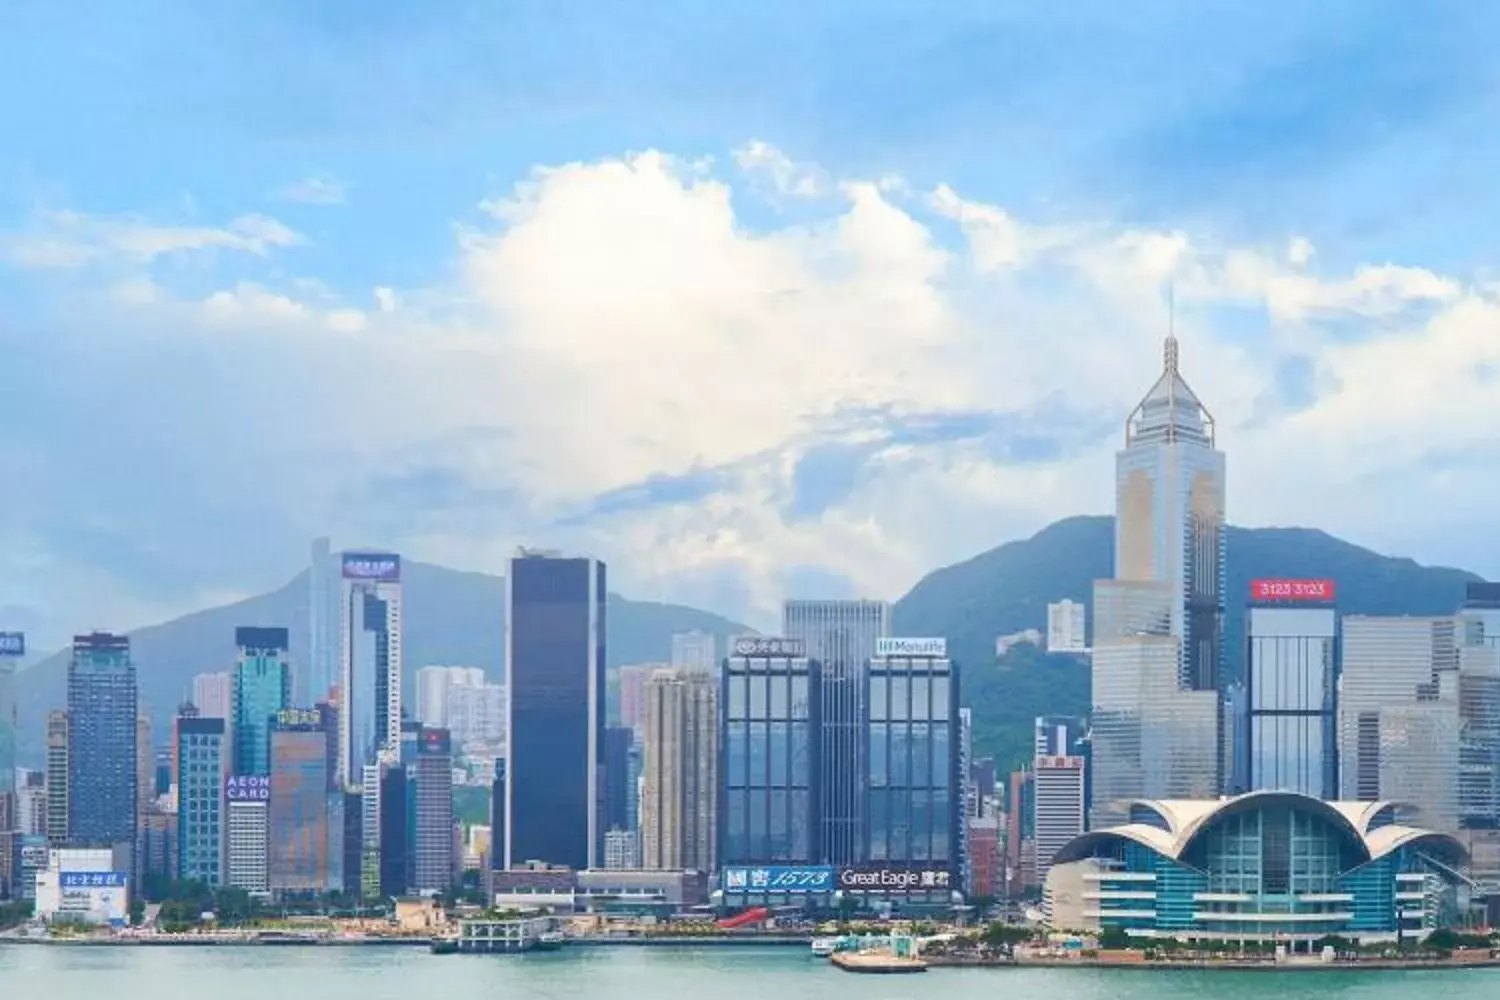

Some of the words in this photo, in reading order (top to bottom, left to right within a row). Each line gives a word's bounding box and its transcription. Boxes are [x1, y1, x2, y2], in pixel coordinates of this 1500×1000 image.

[227, 776, 269, 787] AEON
[227, 788, 269, 799] CARD
[772, 870, 830, 887] 1573
[841, 869, 879, 885] Great
[881, 869, 918, 889] Eagle
